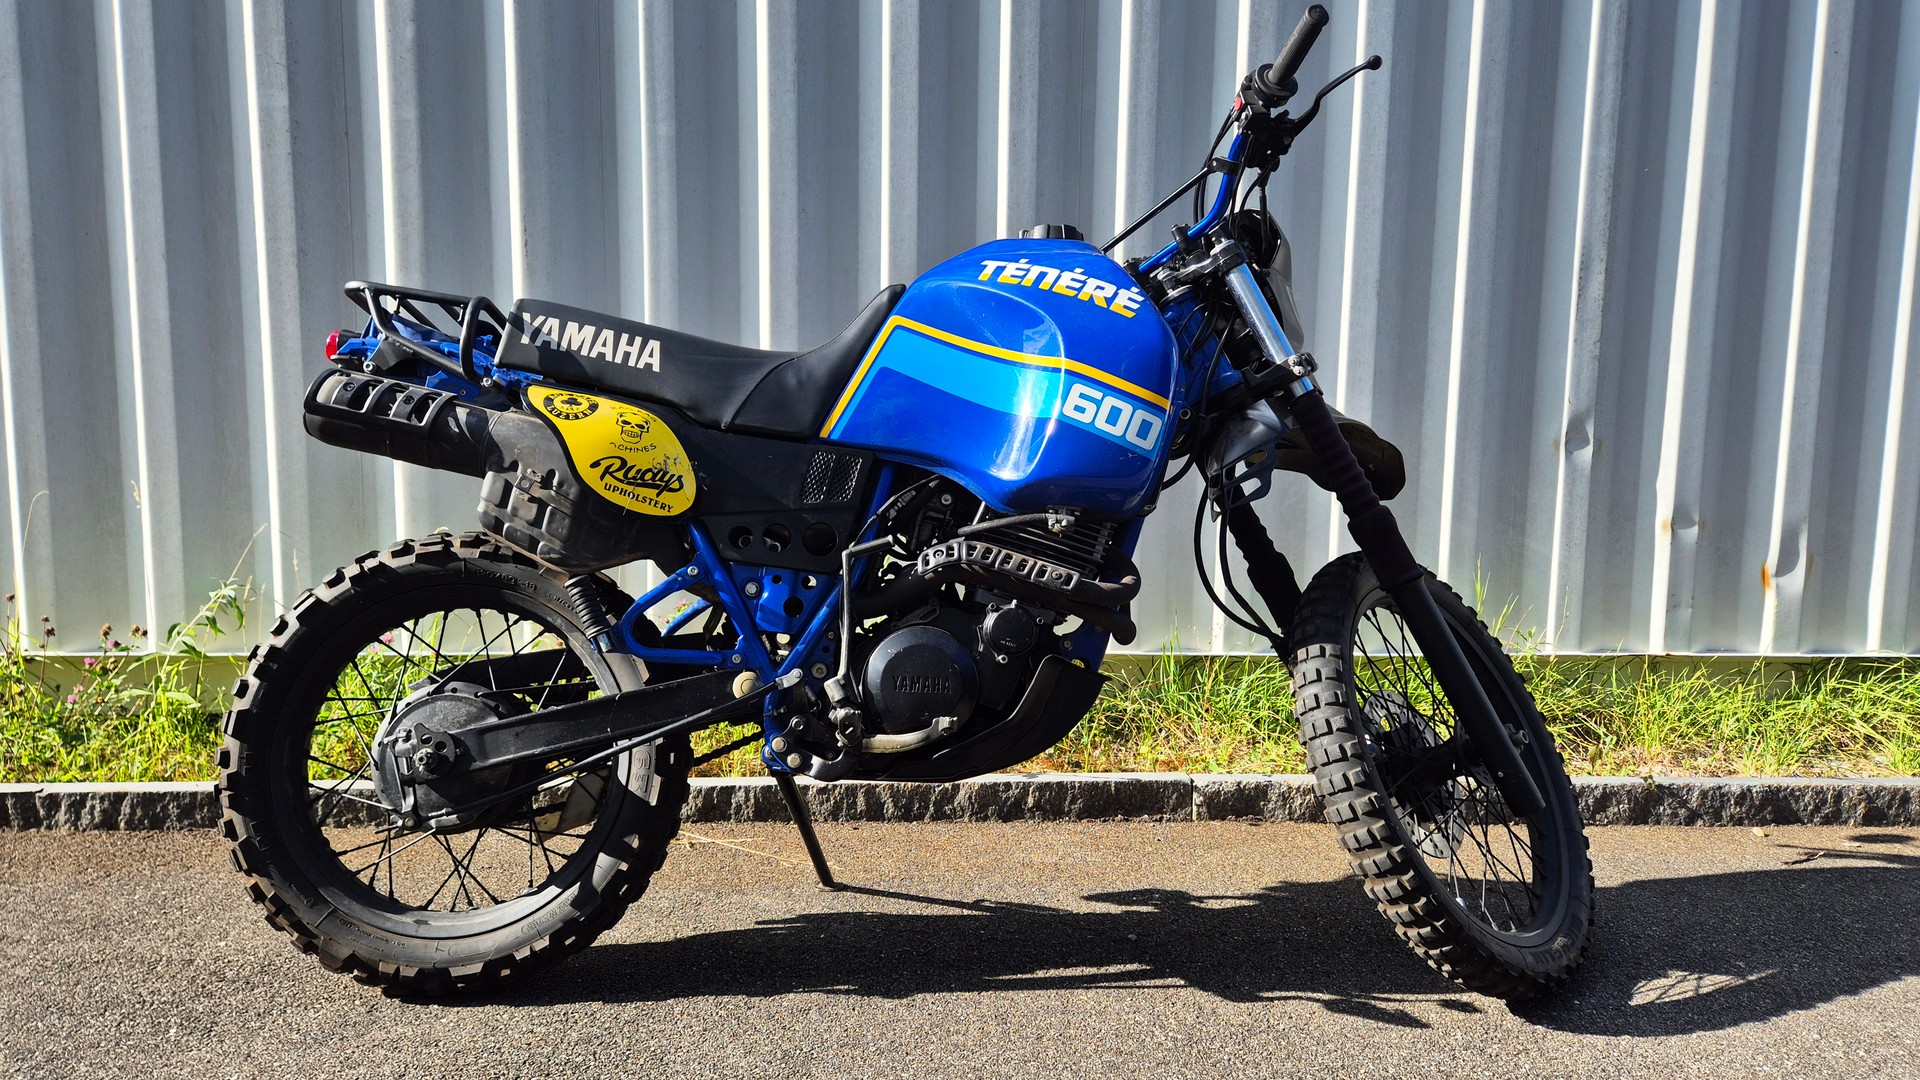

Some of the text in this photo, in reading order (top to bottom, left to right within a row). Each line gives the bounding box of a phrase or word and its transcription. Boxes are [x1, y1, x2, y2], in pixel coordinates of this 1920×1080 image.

[521, 312, 661, 373] YAMAHA
[547, 405, 593, 420] LUZERN
[1062, 383, 1162, 450] 600
[609, 441, 657, 453] CHINES
[604, 483, 674, 513] UPHOLSTERY
[893, 675, 952, 694] YAMAHA
